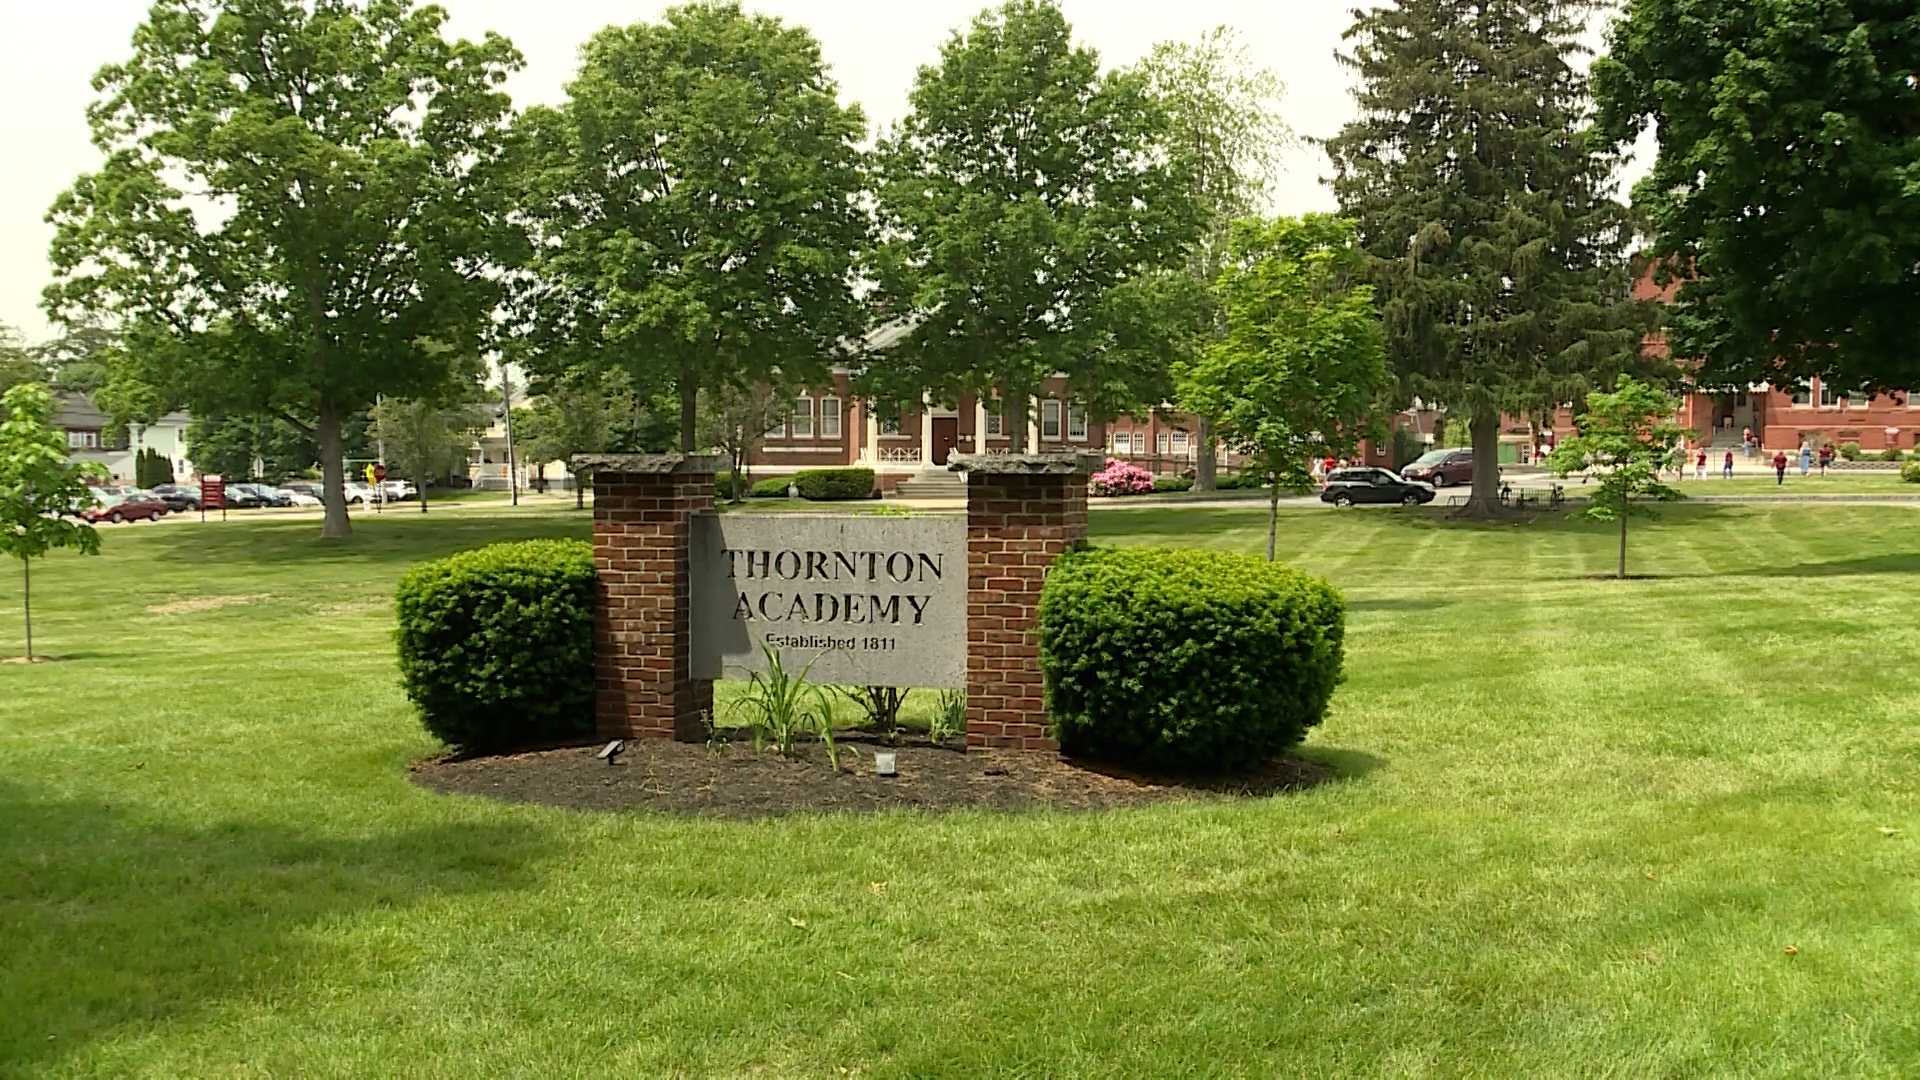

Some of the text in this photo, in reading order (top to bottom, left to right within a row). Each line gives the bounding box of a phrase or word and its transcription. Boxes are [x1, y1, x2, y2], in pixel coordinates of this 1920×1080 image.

[721, 549, 944, 583] THORNTON
[732, 591, 931, 626] ACADEMY
[765, 632, 896, 650] Established 1811
